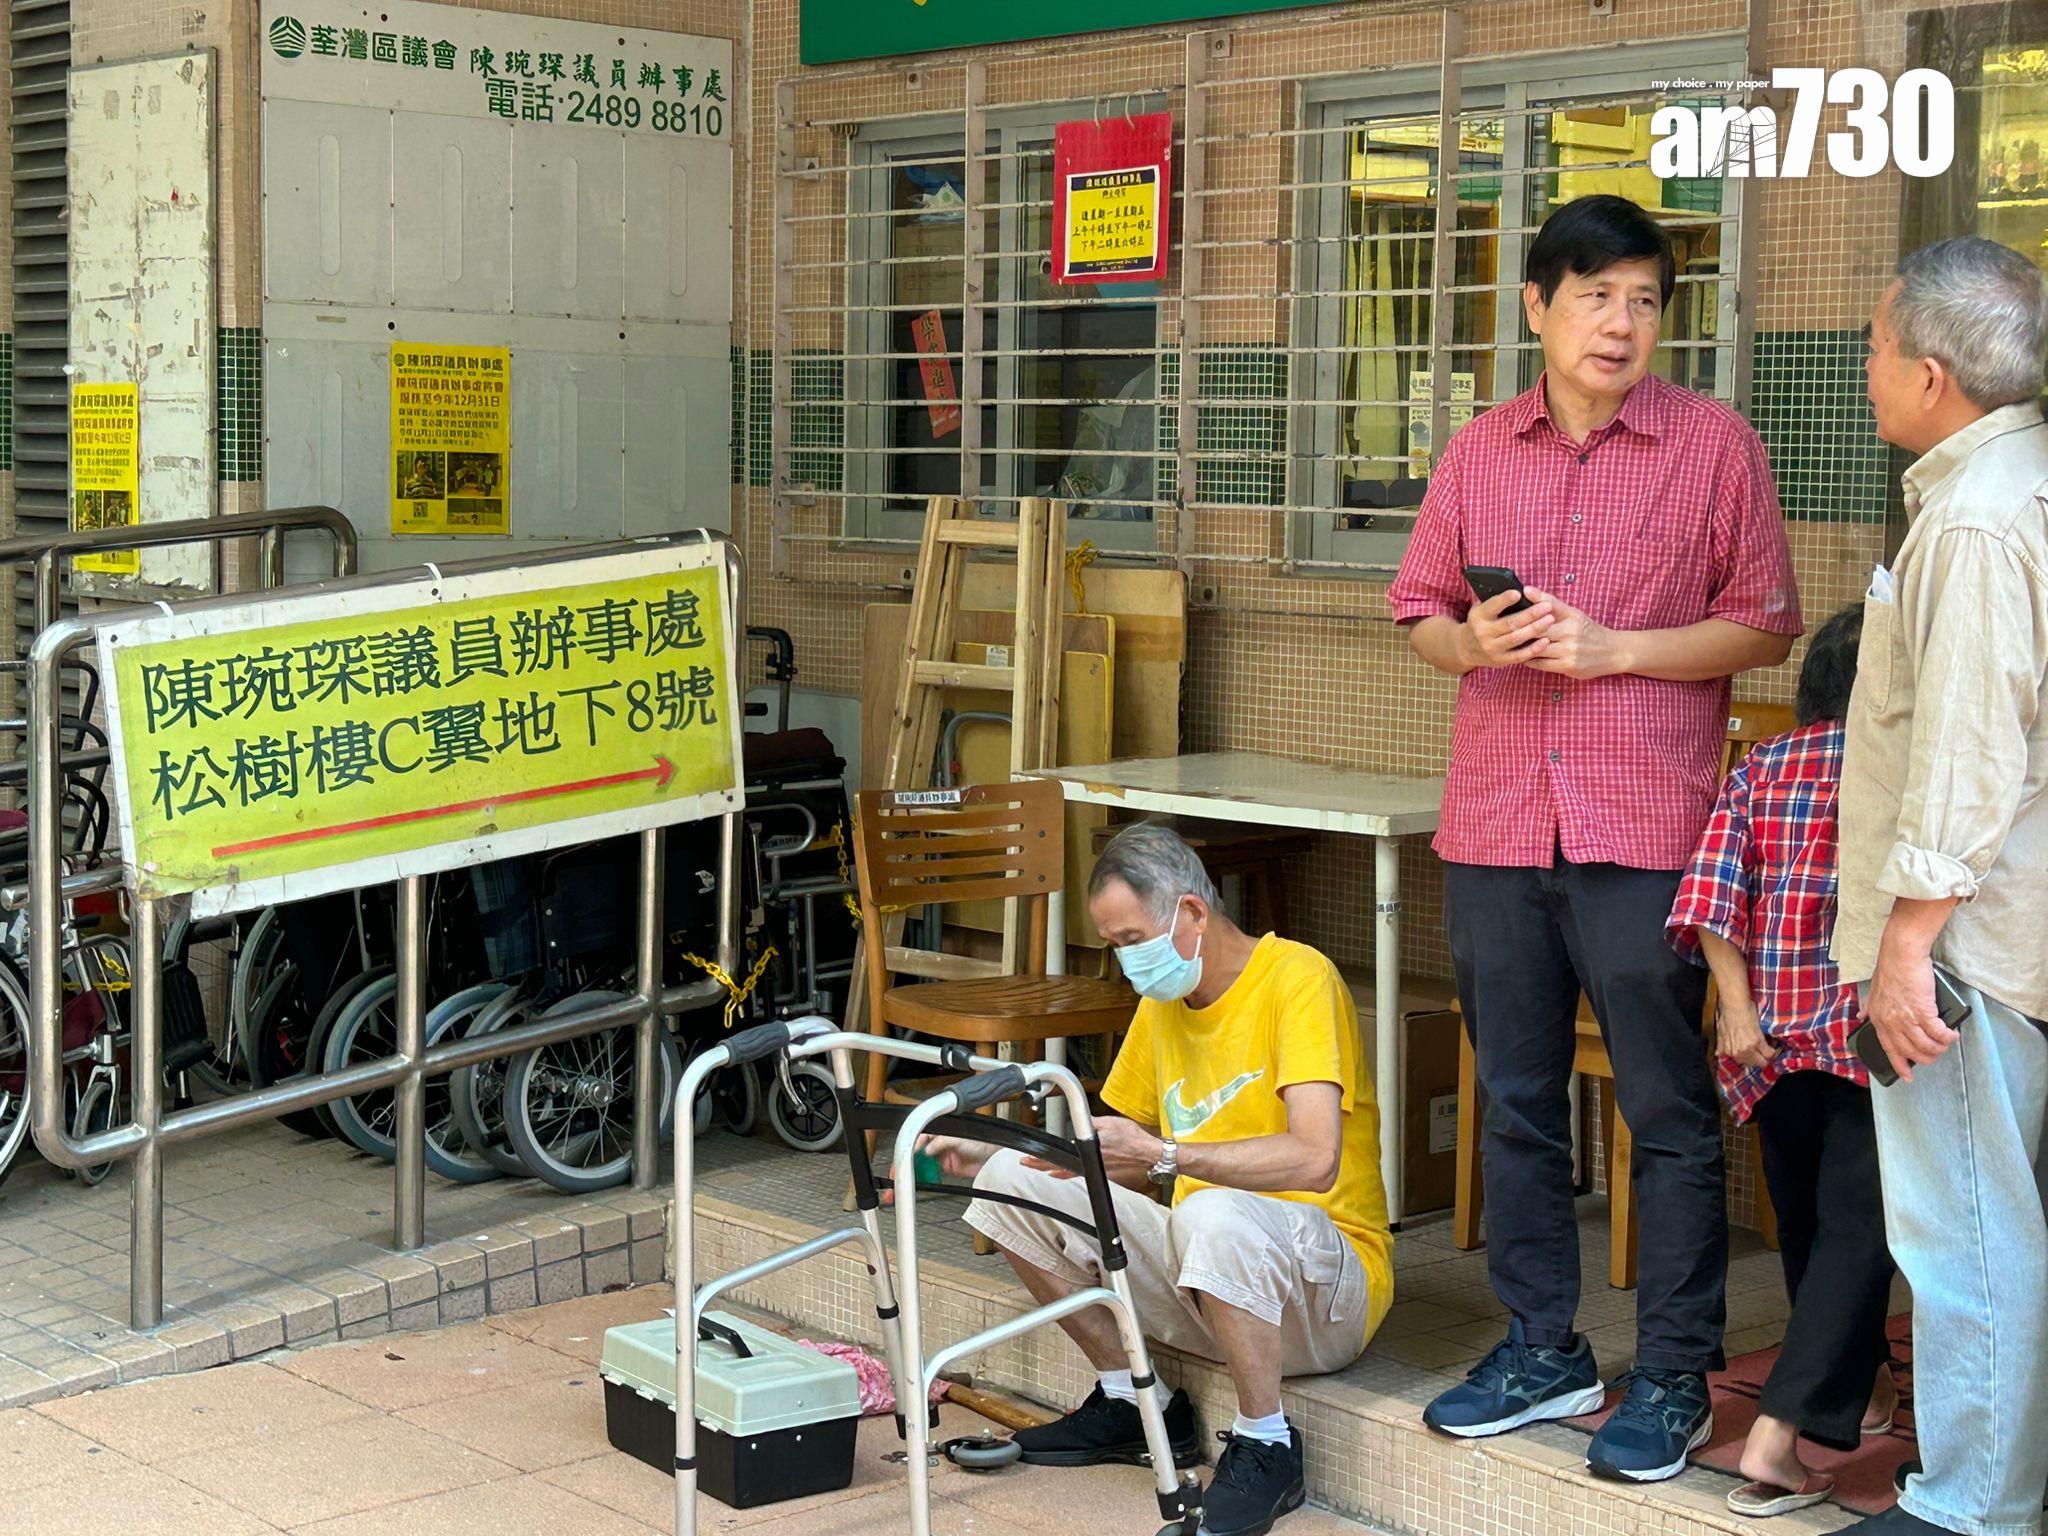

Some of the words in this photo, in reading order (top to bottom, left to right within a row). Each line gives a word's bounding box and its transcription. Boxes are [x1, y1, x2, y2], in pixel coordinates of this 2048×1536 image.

[310, 24, 458, 70] 荃灣區議會
[470, 45, 728, 103] 陳琬琛議員辦事處
[651, 99, 723, 137] 8810
[139, 588, 708, 734] 陳琬琛議員辦事處
[151, 665, 717, 821] 松樹樓C翼地下8號
